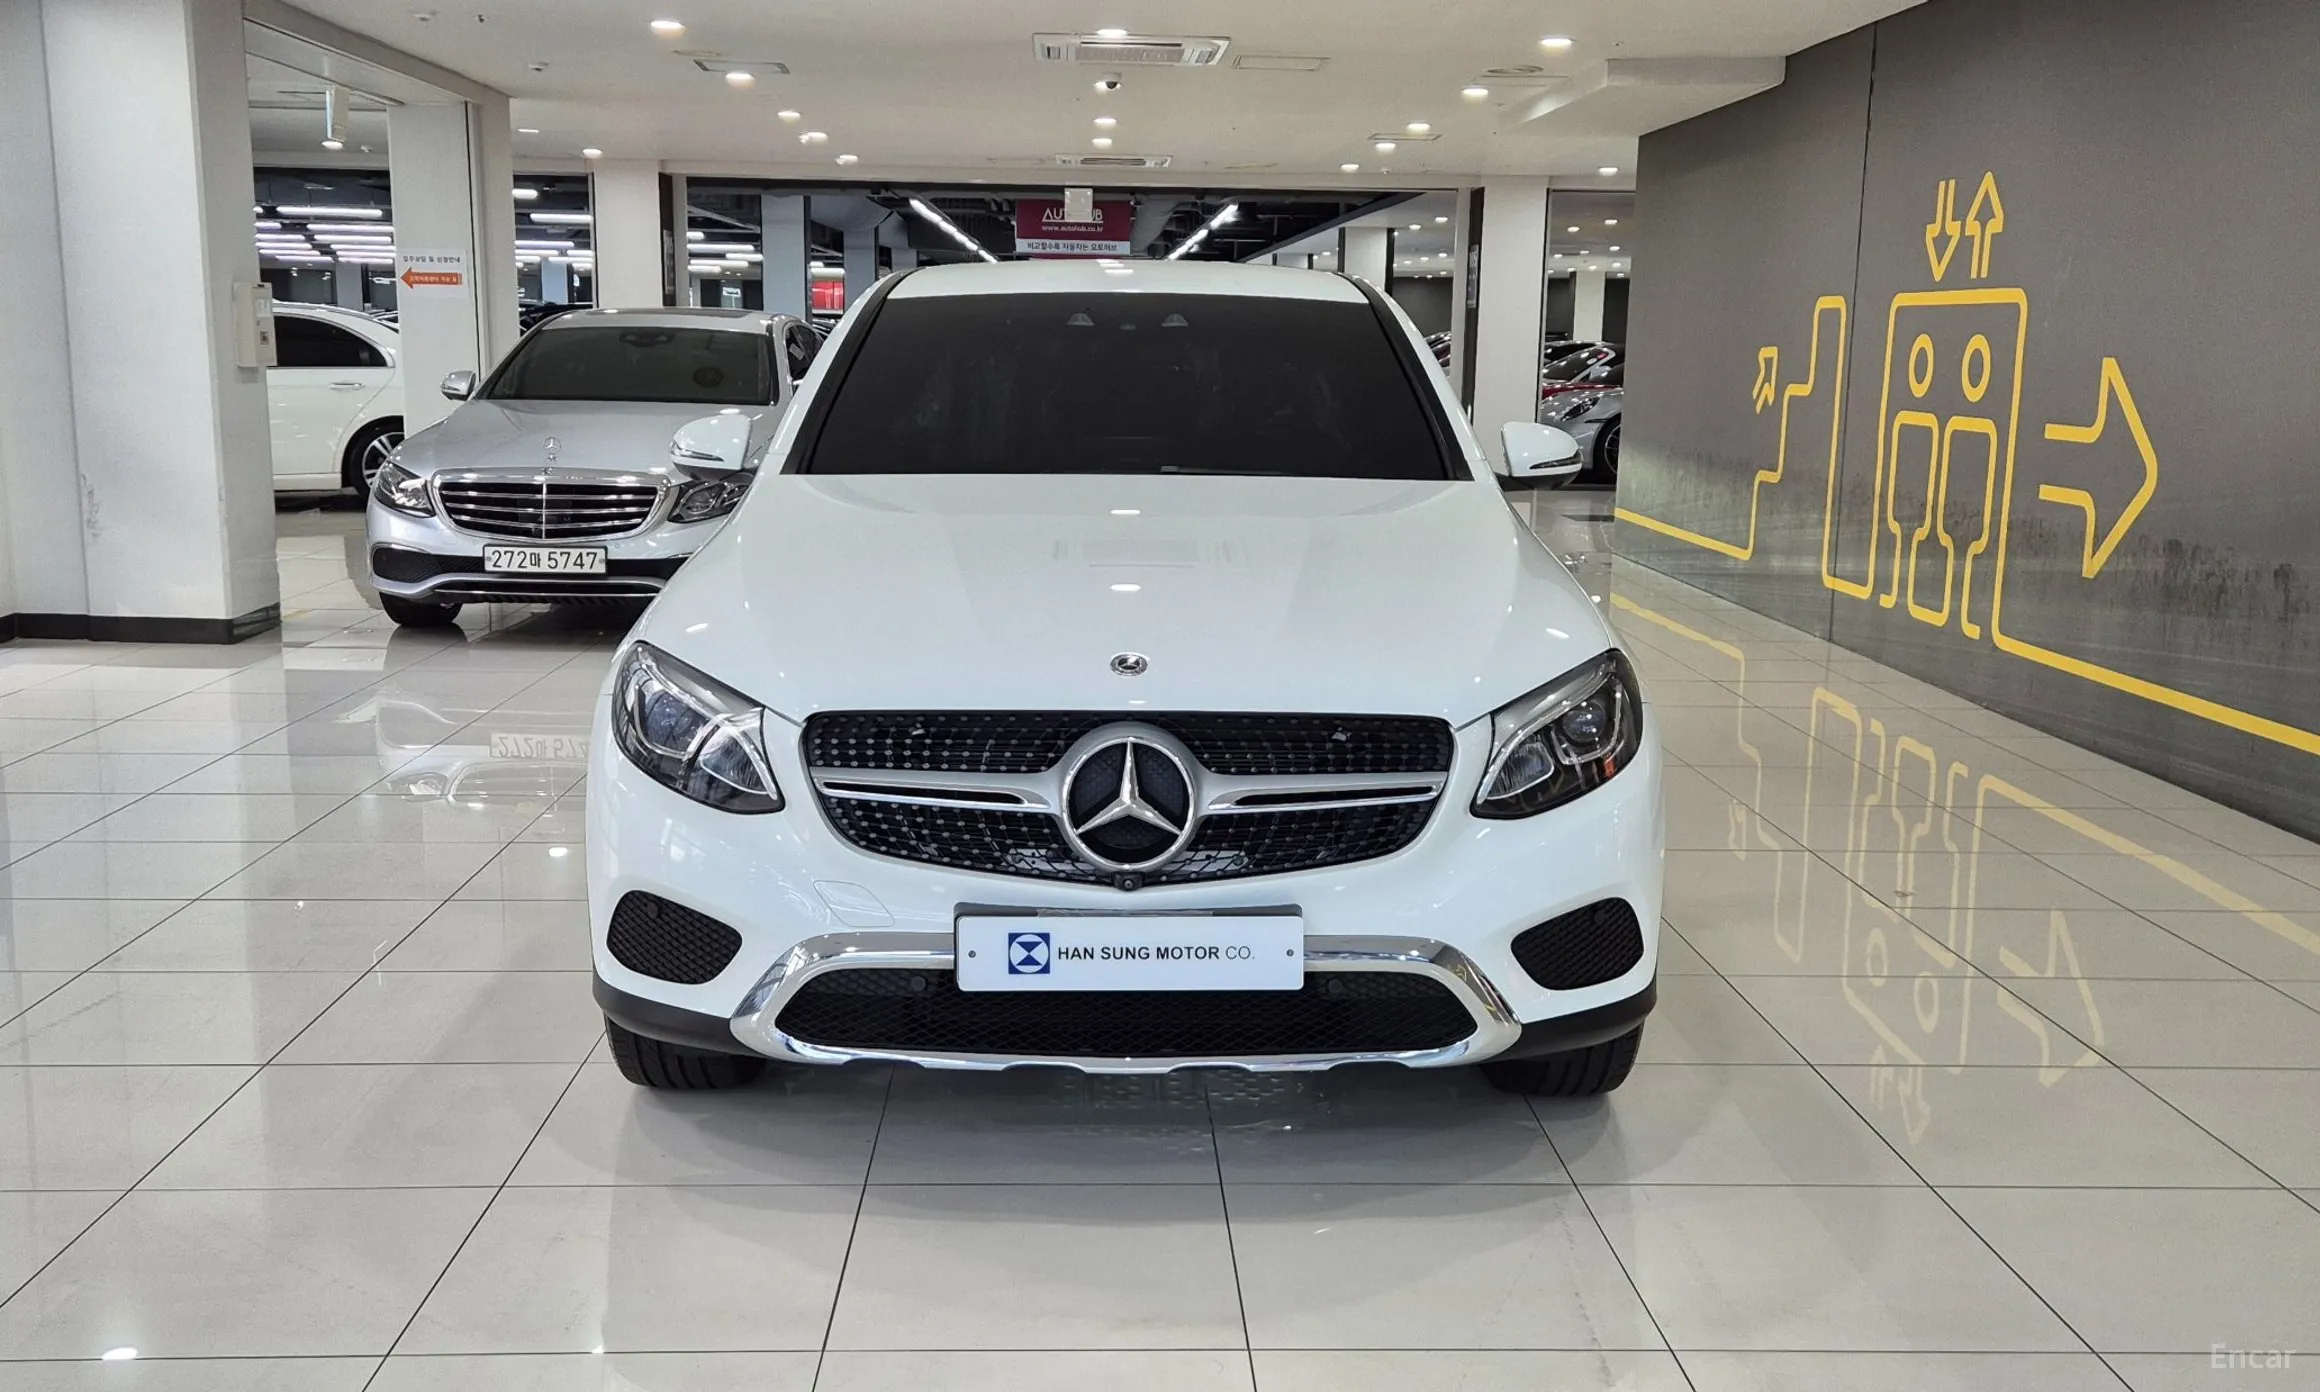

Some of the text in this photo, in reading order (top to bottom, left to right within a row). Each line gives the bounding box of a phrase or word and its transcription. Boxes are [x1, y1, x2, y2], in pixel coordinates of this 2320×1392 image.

[1027, 241, 1118, 251] 비교할수록 자동차는 오토허브
[491, 550, 598, 569] 272마 5747
[1057, 945, 1256, 961] HAN SUNG MOTOR CO.
